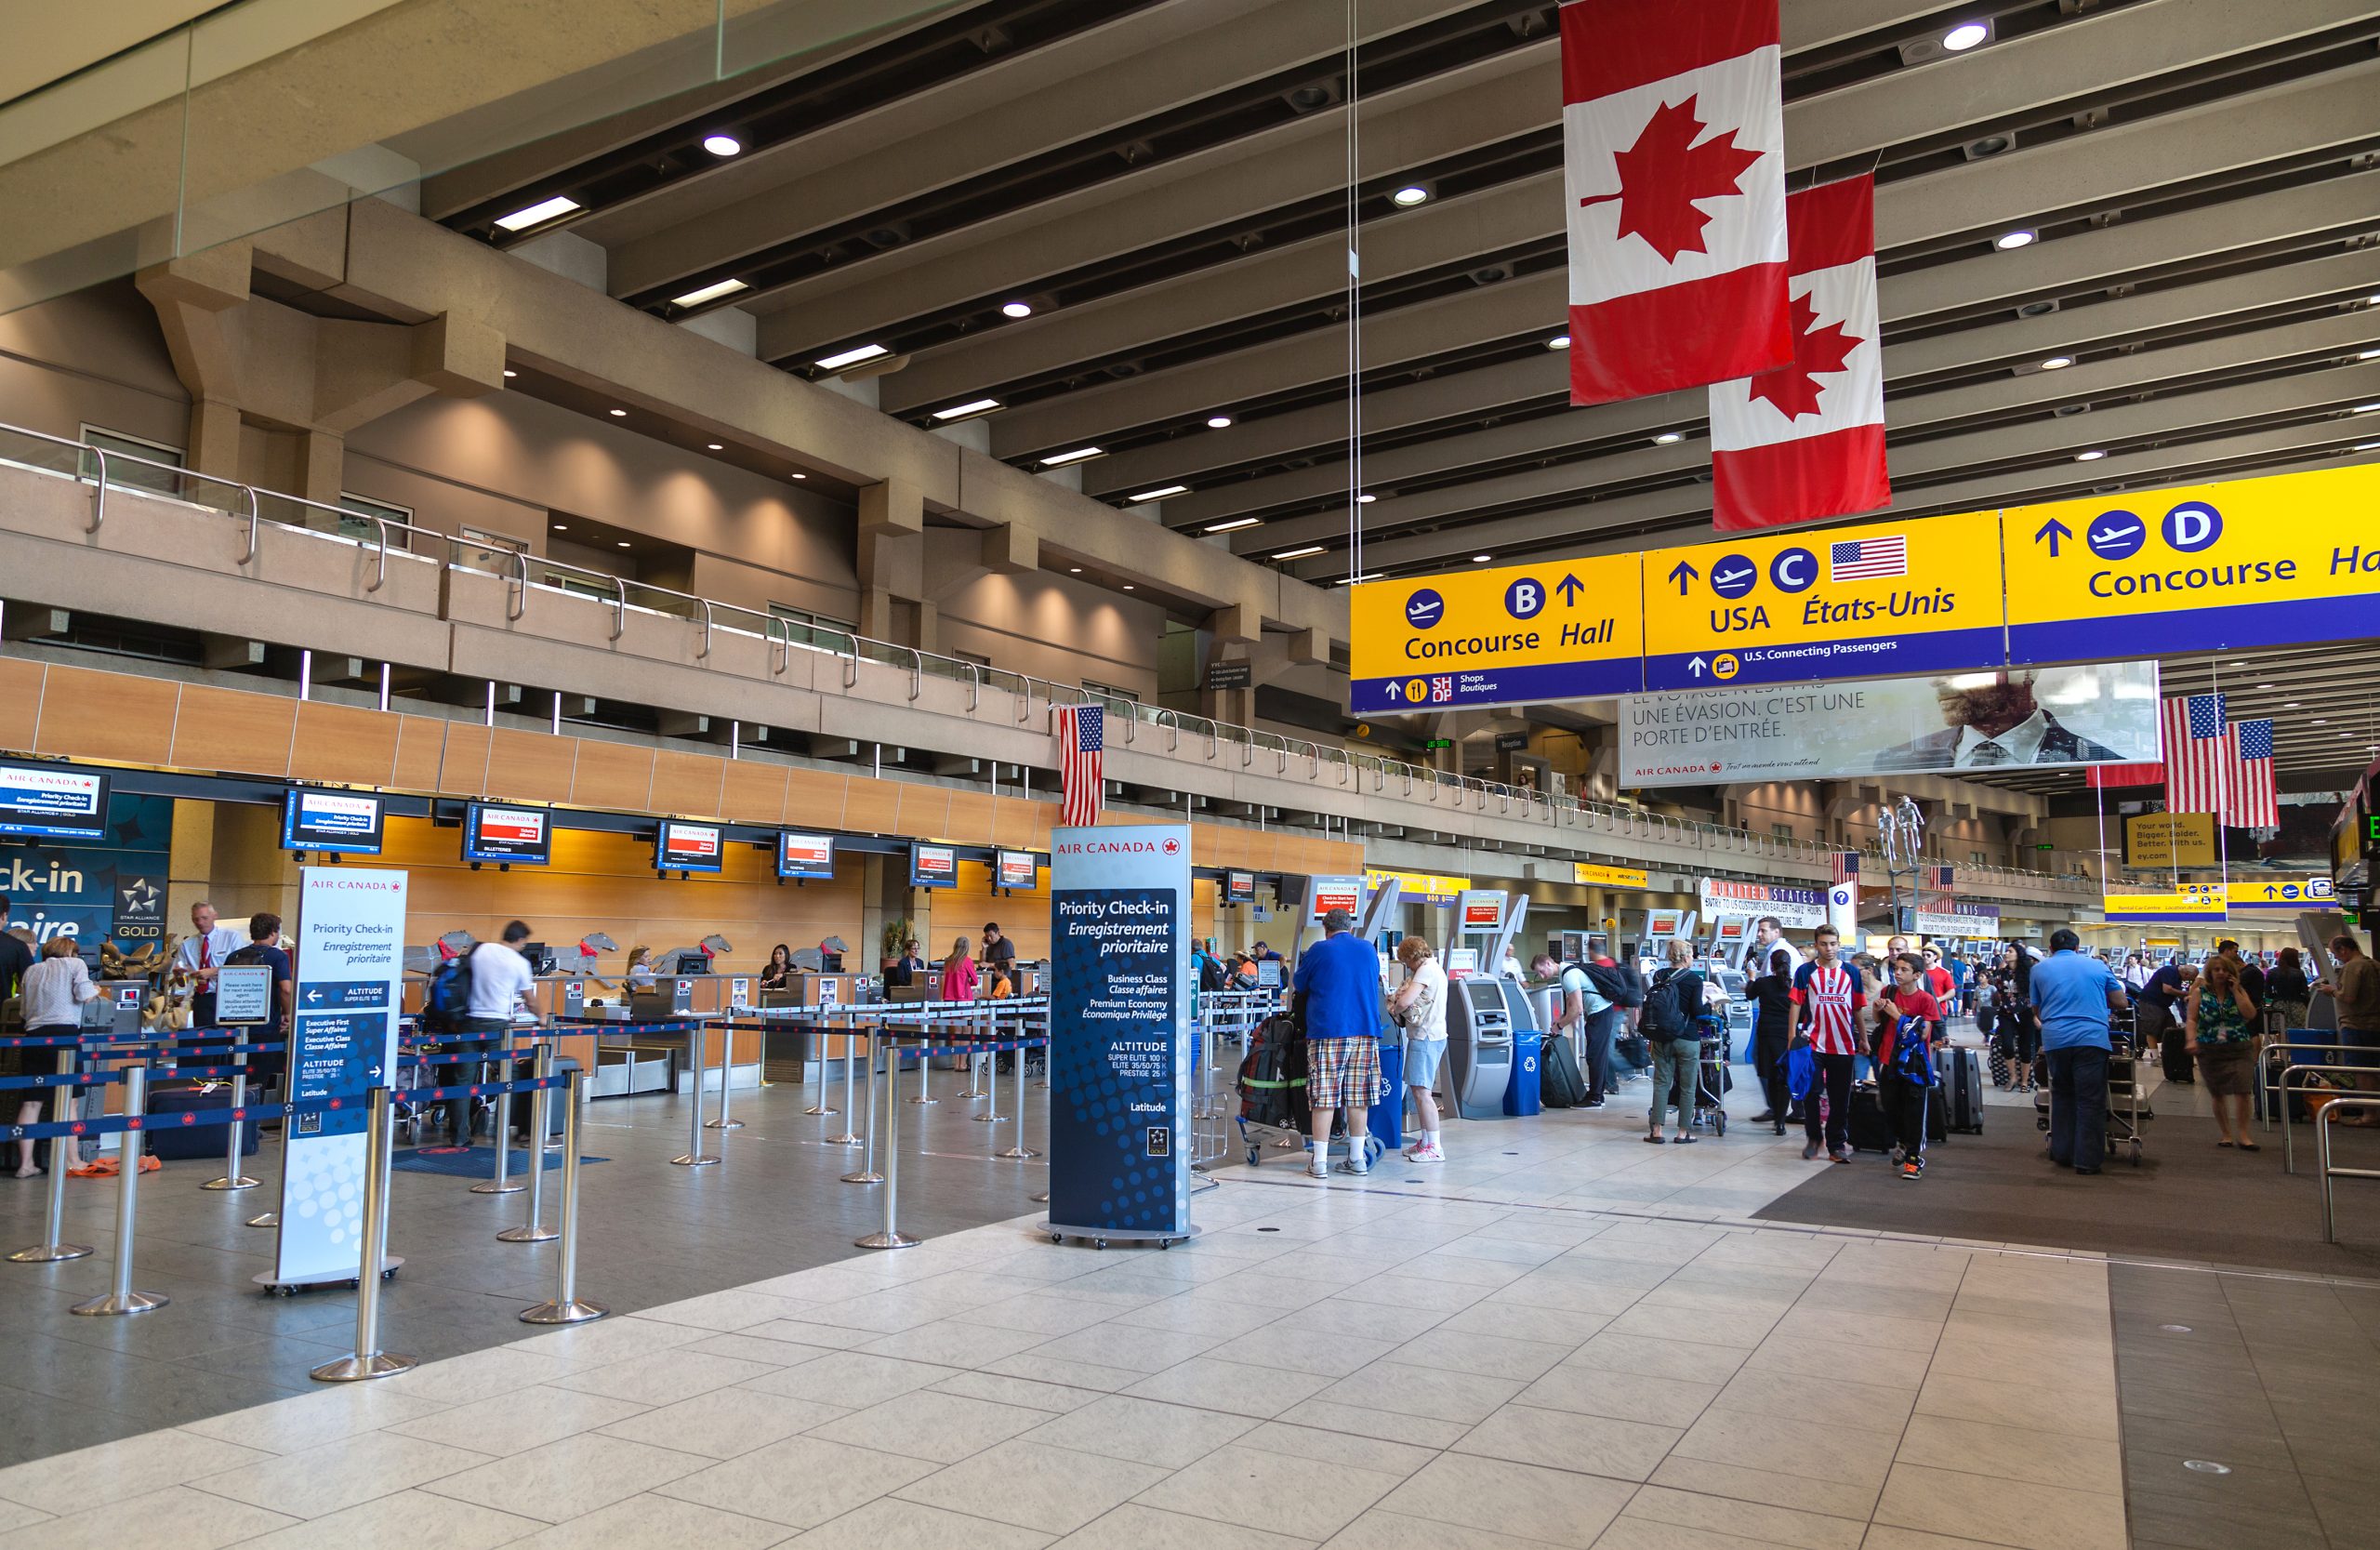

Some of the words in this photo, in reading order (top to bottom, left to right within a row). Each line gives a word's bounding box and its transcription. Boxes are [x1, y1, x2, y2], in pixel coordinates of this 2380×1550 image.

[2175, 510, 2212, 545] D
[1778, 554, 1804, 586] C
[2088, 559, 2297, 598] Concourse
[1515, 584, 1537, 614] B
[1710, 605, 1771, 633] USA
[1802, 587, 1955, 626] États-Unis
[1405, 631, 1540, 659] Concourse
[1560, 618, 1615, 646] Hall
[1744, 650, 1765, 662] U.S.
[1767, 646, 1831, 662] Connecting
[1832, 640, 1897, 656] Passengers
[1460, 674, 1484, 684] Shops
[1460, 682, 1498, 693] Boutiques
[1633, 709, 1670, 725] UNE
[1676, 701, 1761, 722] ÉVASION.
[1824, 692, 1865, 711] UNE
[1633, 728, 1688, 748] PORTE
[1696, 719, 1786, 743] D'ENTRÉE.
[1635, 767, 1654, 776] AIR
[1657, 764, 1705, 775] CANADA
[7, 774, 25, 782] AIR
[30, 776, 78, 787] CANADA
[41, 792, 62, 801] Priority
[2136, 831, 2166, 840] Bigger.
[1057, 843, 1081, 854] AIR
[1087, 841, 1156, 854] CANADA
[311, 881, 334, 889] AIR
[337, 881, 387, 890] CANADA
[1718, 882, 1765, 901] UNITED
[1773, 888, 1814, 903] STATES
[1059, 902, 1106, 919] Priority
[1109, 900, 1169, 915] Check-in
[1731, 899, 1738, 909] US
[1739, 900, 1761, 911] CUSTOMS
[1763, 902, 1770, 912] NO
[1770, 902, 1788, 913] EARLIER
[119, 926, 159, 937] GOLD
[313, 923, 352, 935] Priority
[355, 923, 393, 934] Check-in
[1068, 921, 1169, 938] Enregistrement
[323, 941, 392, 954] Enregistrement
[1100, 939, 1169, 958] prioritaire
[346, 954, 391, 966] prioritaire
[1107, 974, 1143, 984] Business
[1144, 974, 1168, 984] Class
[1109, 986, 1134, 995] Classe
[1135, 985, 1168, 997] affaires
[1090, 999, 1126, 1008] Premium
[1128, 1000, 1168, 1011] Economy
[1082, 1008, 1130, 1022] Économique
[1131, 1009, 1168, 1022] Privilège
[324, 1042, 347, 1051] Affaires
[1111, 1042, 1168, 1052] ALTITUDE
[303, 1059, 344, 1068] ALTITUDE
[1107, 1053, 1128, 1062] SUPER
[1130, 1053, 1146, 1062] ELITE
[301, 1089, 328, 1097] Latitude
[1130, 1103, 1167, 1112] Latitude
